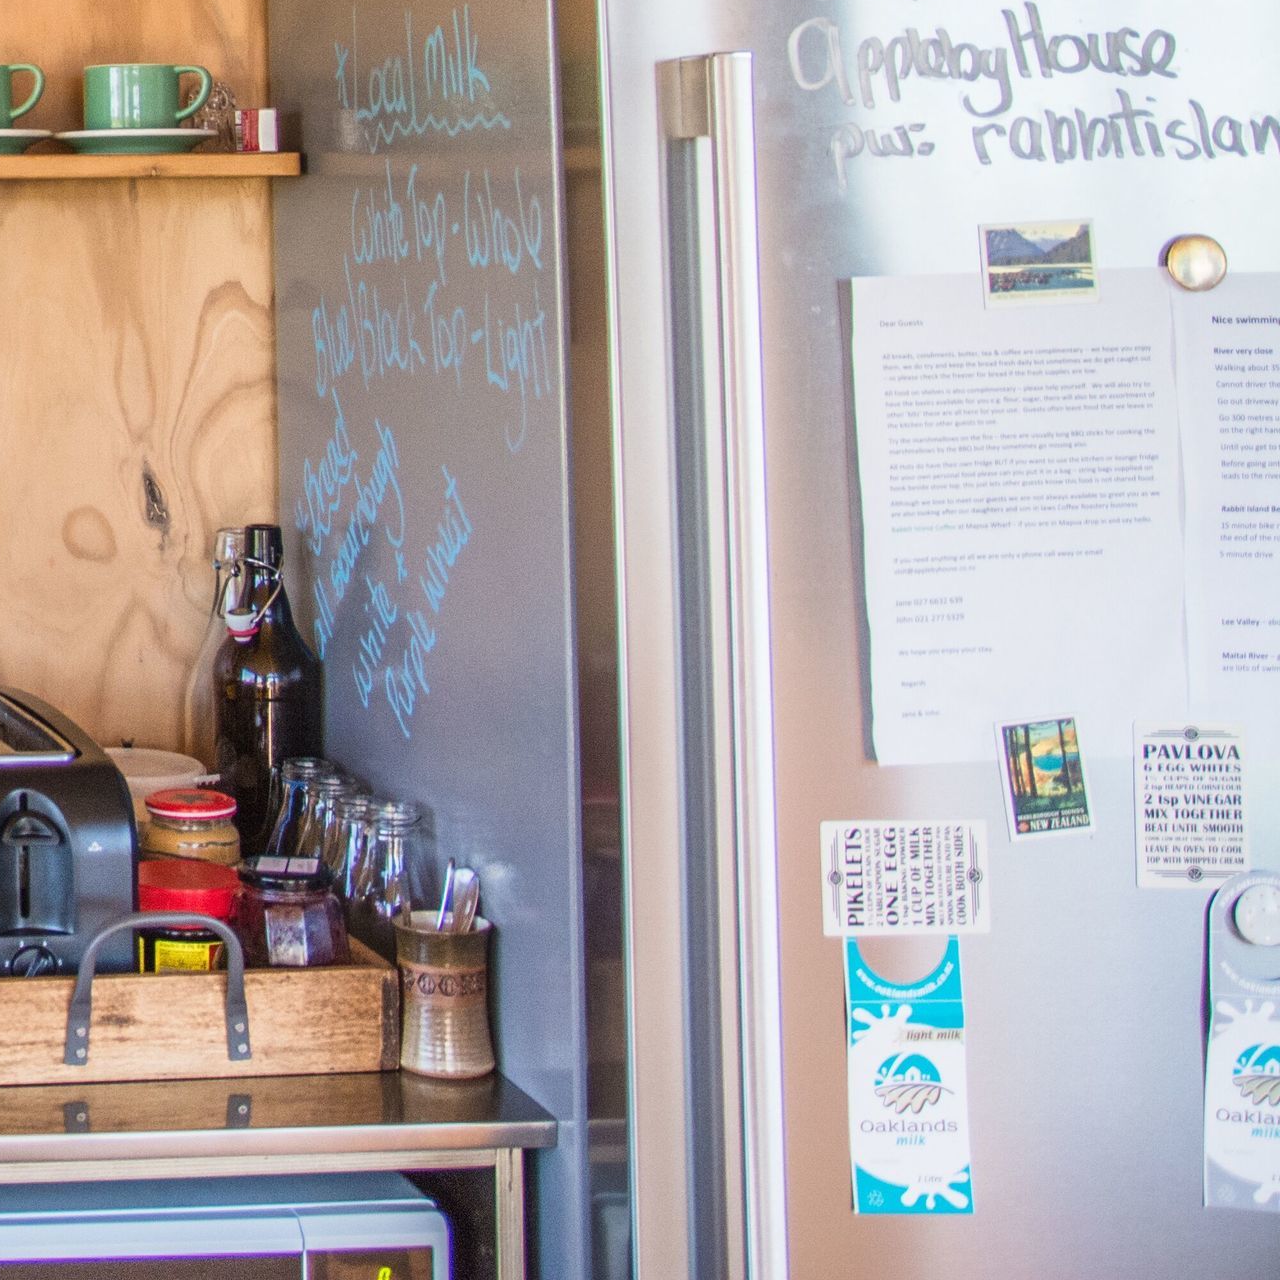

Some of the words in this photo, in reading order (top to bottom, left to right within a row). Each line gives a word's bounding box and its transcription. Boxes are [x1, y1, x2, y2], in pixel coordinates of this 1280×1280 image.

[879, 319, 896, 328] Dear
[897, 319, 925, 328] Guests
[1211, 315, 1233, 325] Nice
[1213, 346, 1233, 356] River
[1235, 348, 1252, 357] very
[1253, 346, 1274, 355] close
[1214, 363, 1246, 374] Walking
[1247, 363, 1269, 372] about
[1216, 380, 1243, 388] Cannot
[1245, 380, 1267, 388] driver
[1217, 397, 1228, 406] Go
[1230, 397, 1243, 406] out
[1244, 397, 1279, 408] driveway
[1219, 414, 1230, 422] Go
[1231, 414, 1246, 422] 300
[1247, 414, 1273, 422] metres
[1231, 426, 1244, 434] the
[1245, 426, 1263, 436] right
[1240, 444, 1254, 453] you
[1255, 444, 1268, 453] get
[1220, 460, 1245, 468] Before
[1246, 461, 1267, 470] going
[1221, 472, 1240, 480] leads
[1241, 472, 1250, 480] to
[1251, 472, 1263, 480] the
[1221, 505, 1245, 513] Rabbit
[1246, 505, 1270, 513] Island
[1231, 521, 1257, 530] minute
[1258, 521, 1275, 530] bike
[1220, 534, 1232, 542] the
[1233, 534, 1248, 542] end
[1249, 534, 1258, 542] of
[1259, 534, 1272, 542] the
[1226, 550, 1253, 559] minute
[1254, 550, 1274, 559] drive
[1221, 618, 1235, 626] Lee
[1236, 618, 1260, 627] Valley
[1248, 652, 1269, 660] River
[1221, 665, 1234, 673] are
[1251, 664, 1260, 672] of
[1143, 744, 1241, 760] PAVLOVA
[1143, 763, 1152, 773] 6
[1157, 763, 1185, 773] EGG
[1190, 763, 1242, 773] WHITES
[1144, 793, 1153, 805] 2
[1158, 793, 1179, 808] tsp
[1183, 793, 1242, 806] VINEGAR
[1144, 808, 1168, 820] MIX
[1174, 808, 1243, 820] TOGETHER
[1030, 819, 1049, 831] NEW
[1050, 814, 1090, 829] ZEALAND
[1145, 823, 1168, 833] BEAT
[1172, 823, 1198, 833] UNTIL
[1202, 823, 1244, 833] SMOOTH
[909, 827, 920, 860] MILK
[953, 825, 964, 857] SIDES
[883, 827, 897, 872] EGG
[1145, 845, 1170, 854] LEAVE
[1172, 845, 1181, 854] IN
[1183, 845, 1205, 854] OVEN
[1207, 845, 1219, 854] TO
[1220, 845, 1243, 854] COOL
[922, 826, 935, 897] TOGETHER
[1146, 856, 1161, 865] TOP
[1162, 856, 1182, 865] WITH
[1183, 856, 1218, 865] WHIPPED
[1219, 856, 1245, 865] CREAM
[844, 827, 865, 927] PIKELETS
[910, 866, 921, 882] OF
[955, 861, 966, 891] BOTH
[884, 881, 899, 926] ONE
[911, 886, 922, 913] CUP
[926, 902, 936, 926] MIX
[956, 894, 967, 926] COOK
[906, 1029, 934, 1042] light
[936, 1029, 962, 1040] milk
[859, 1119, 959, 1134] Oaklands
[896, 1134, 927, 1146] milk
